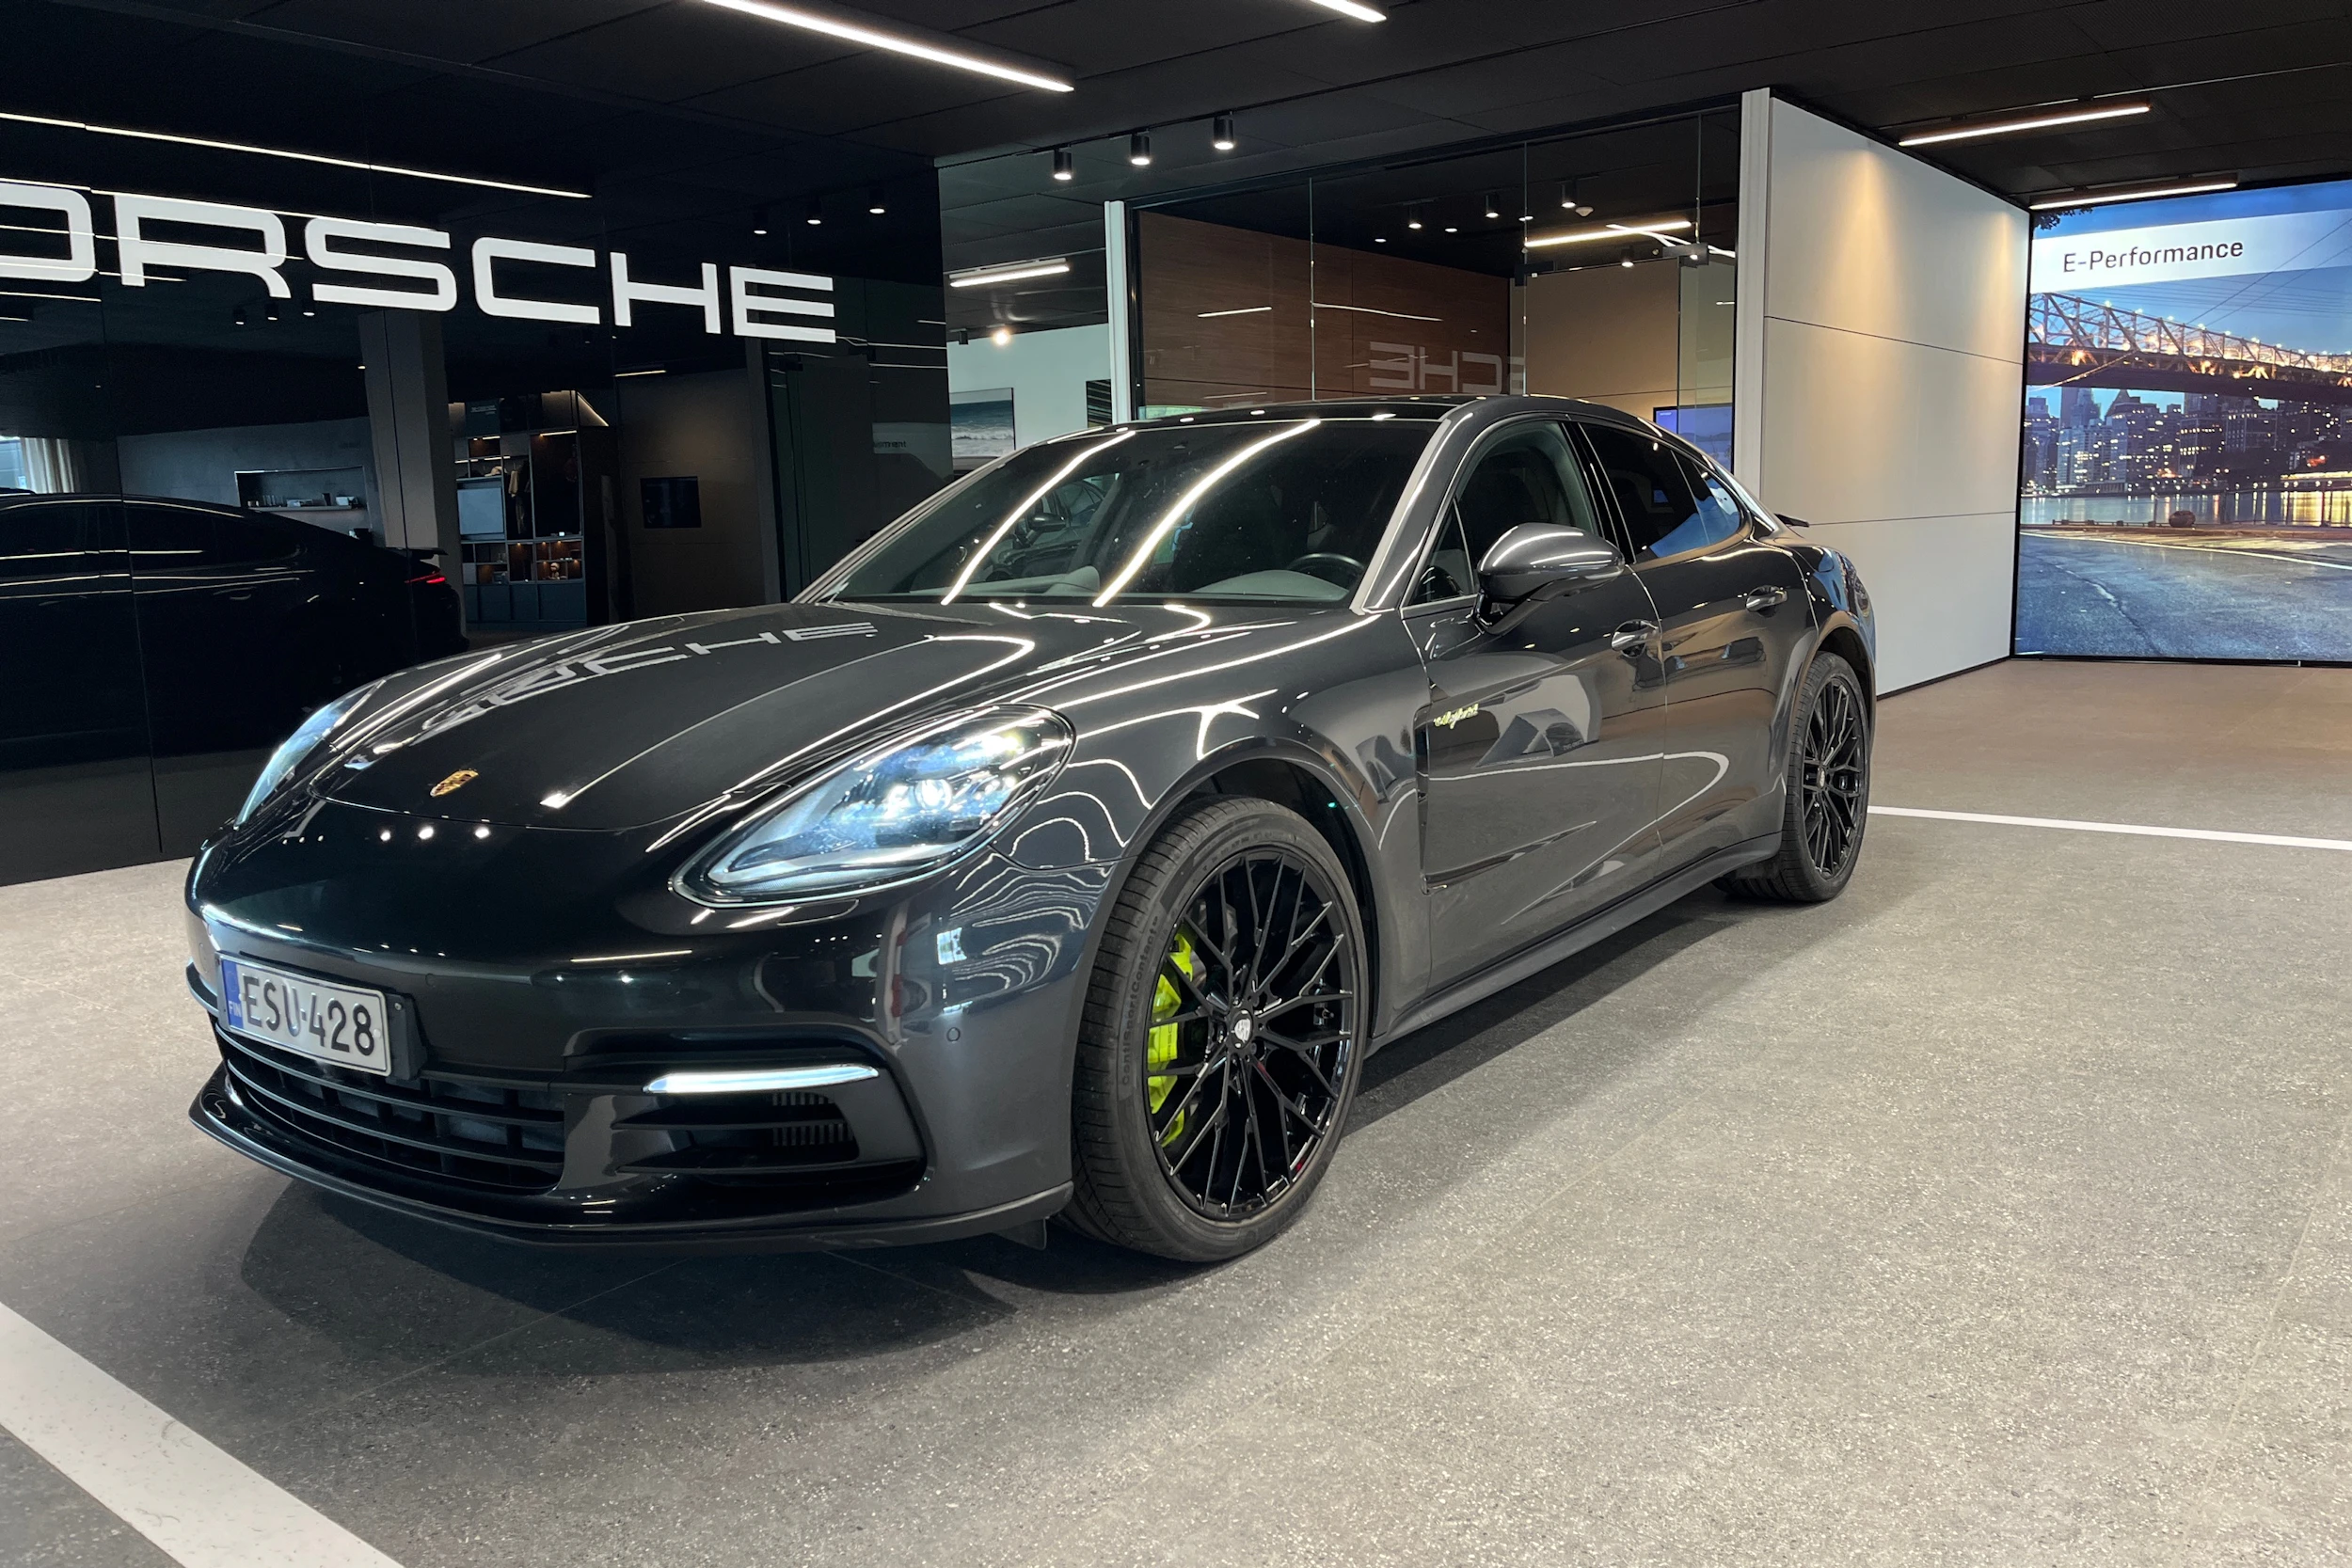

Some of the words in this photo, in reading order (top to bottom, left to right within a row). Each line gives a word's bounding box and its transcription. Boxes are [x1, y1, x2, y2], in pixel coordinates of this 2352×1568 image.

[0, 182, 837, 344] ORSCHE
[2063, 241, 2244, 273] E-Performance
[228, 1000, 242, 1018] FIN
[242, 973, 375, 1056] ESU-428
